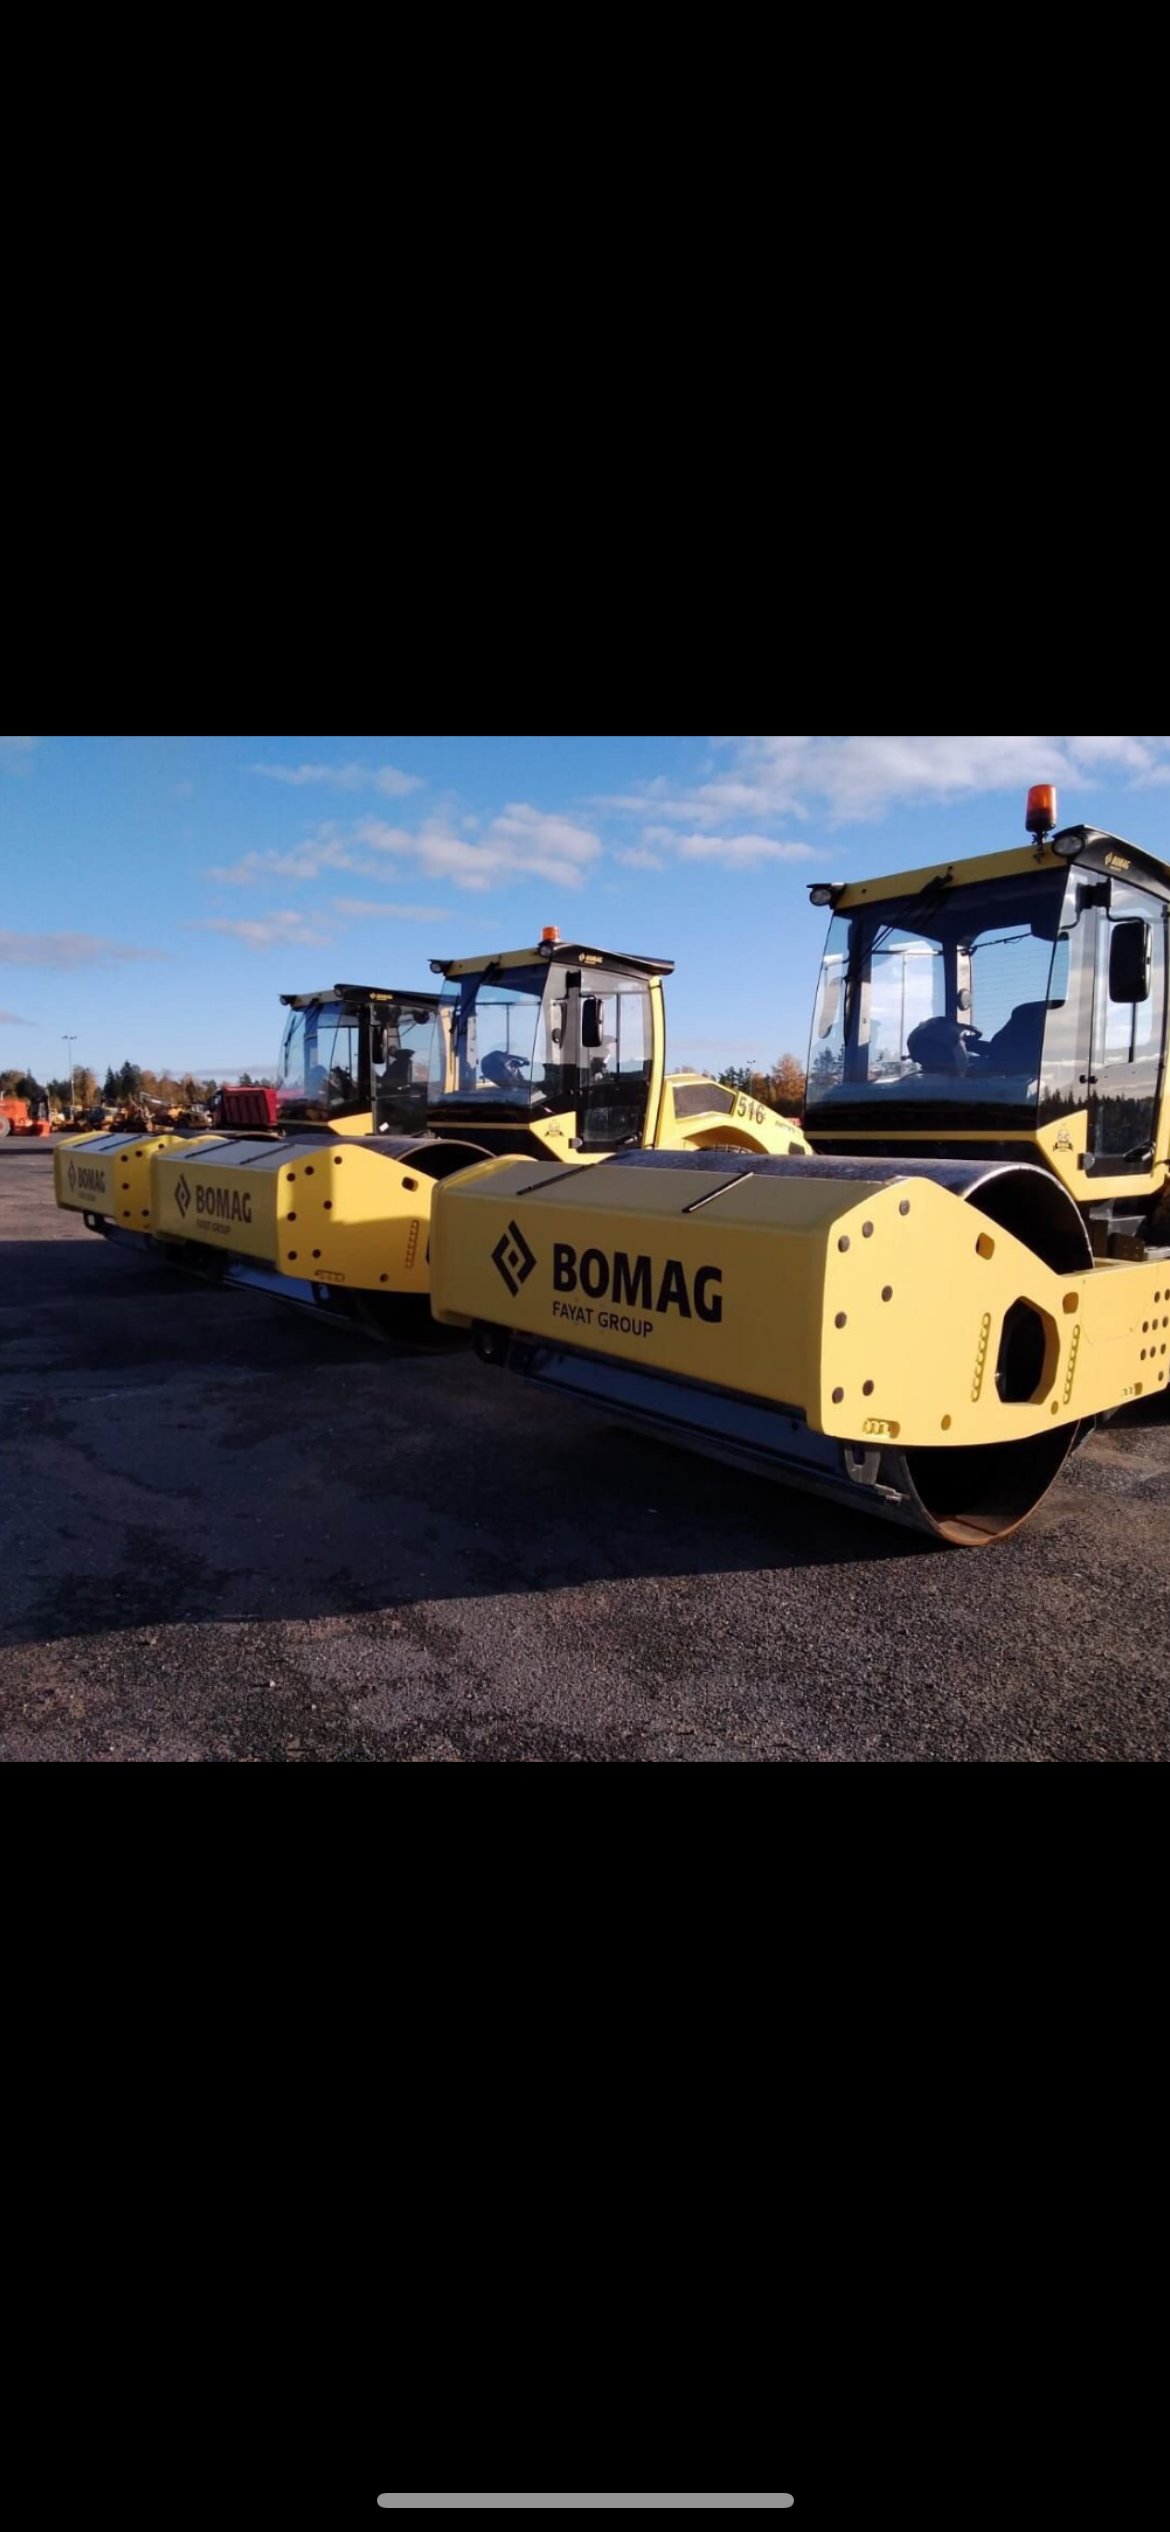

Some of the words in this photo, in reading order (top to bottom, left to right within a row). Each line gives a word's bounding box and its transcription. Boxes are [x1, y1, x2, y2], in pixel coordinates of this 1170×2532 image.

[737, 1096, 765, 1125] 516
[77, 1166, 106, 1194] BOMAG
[196, 1184, 252, 1223] BOMAG
[553, 1243, 723, 1323] BOMAG
[552, 1301, 594, 1325] FAYAT
[598, 1311, 653, 1338] GROUP
